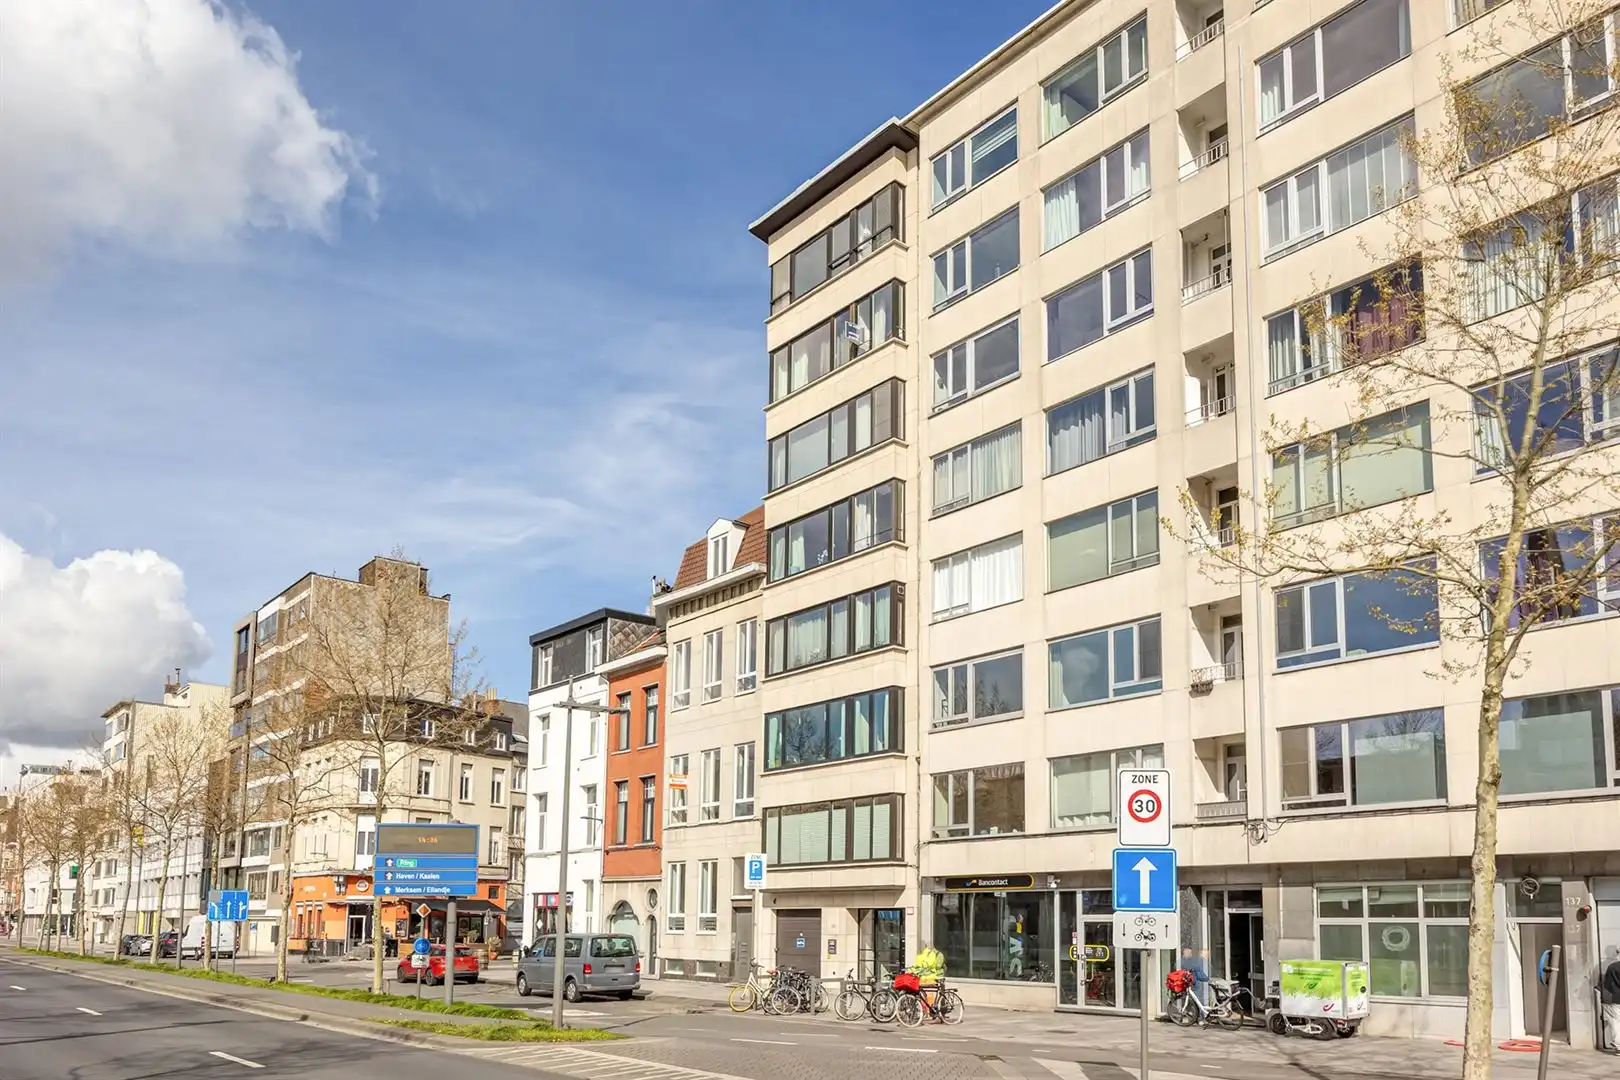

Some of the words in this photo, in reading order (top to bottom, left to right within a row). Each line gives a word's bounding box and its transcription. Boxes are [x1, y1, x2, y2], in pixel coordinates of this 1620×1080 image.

[1131, 774, 1159, 784] ZONE
[1134, 799, 1156, 813] 30
[400, 859, 414, 867] Ring
[752, 862, 760, 873] P
[1566, 897, 1580, 905] 137
